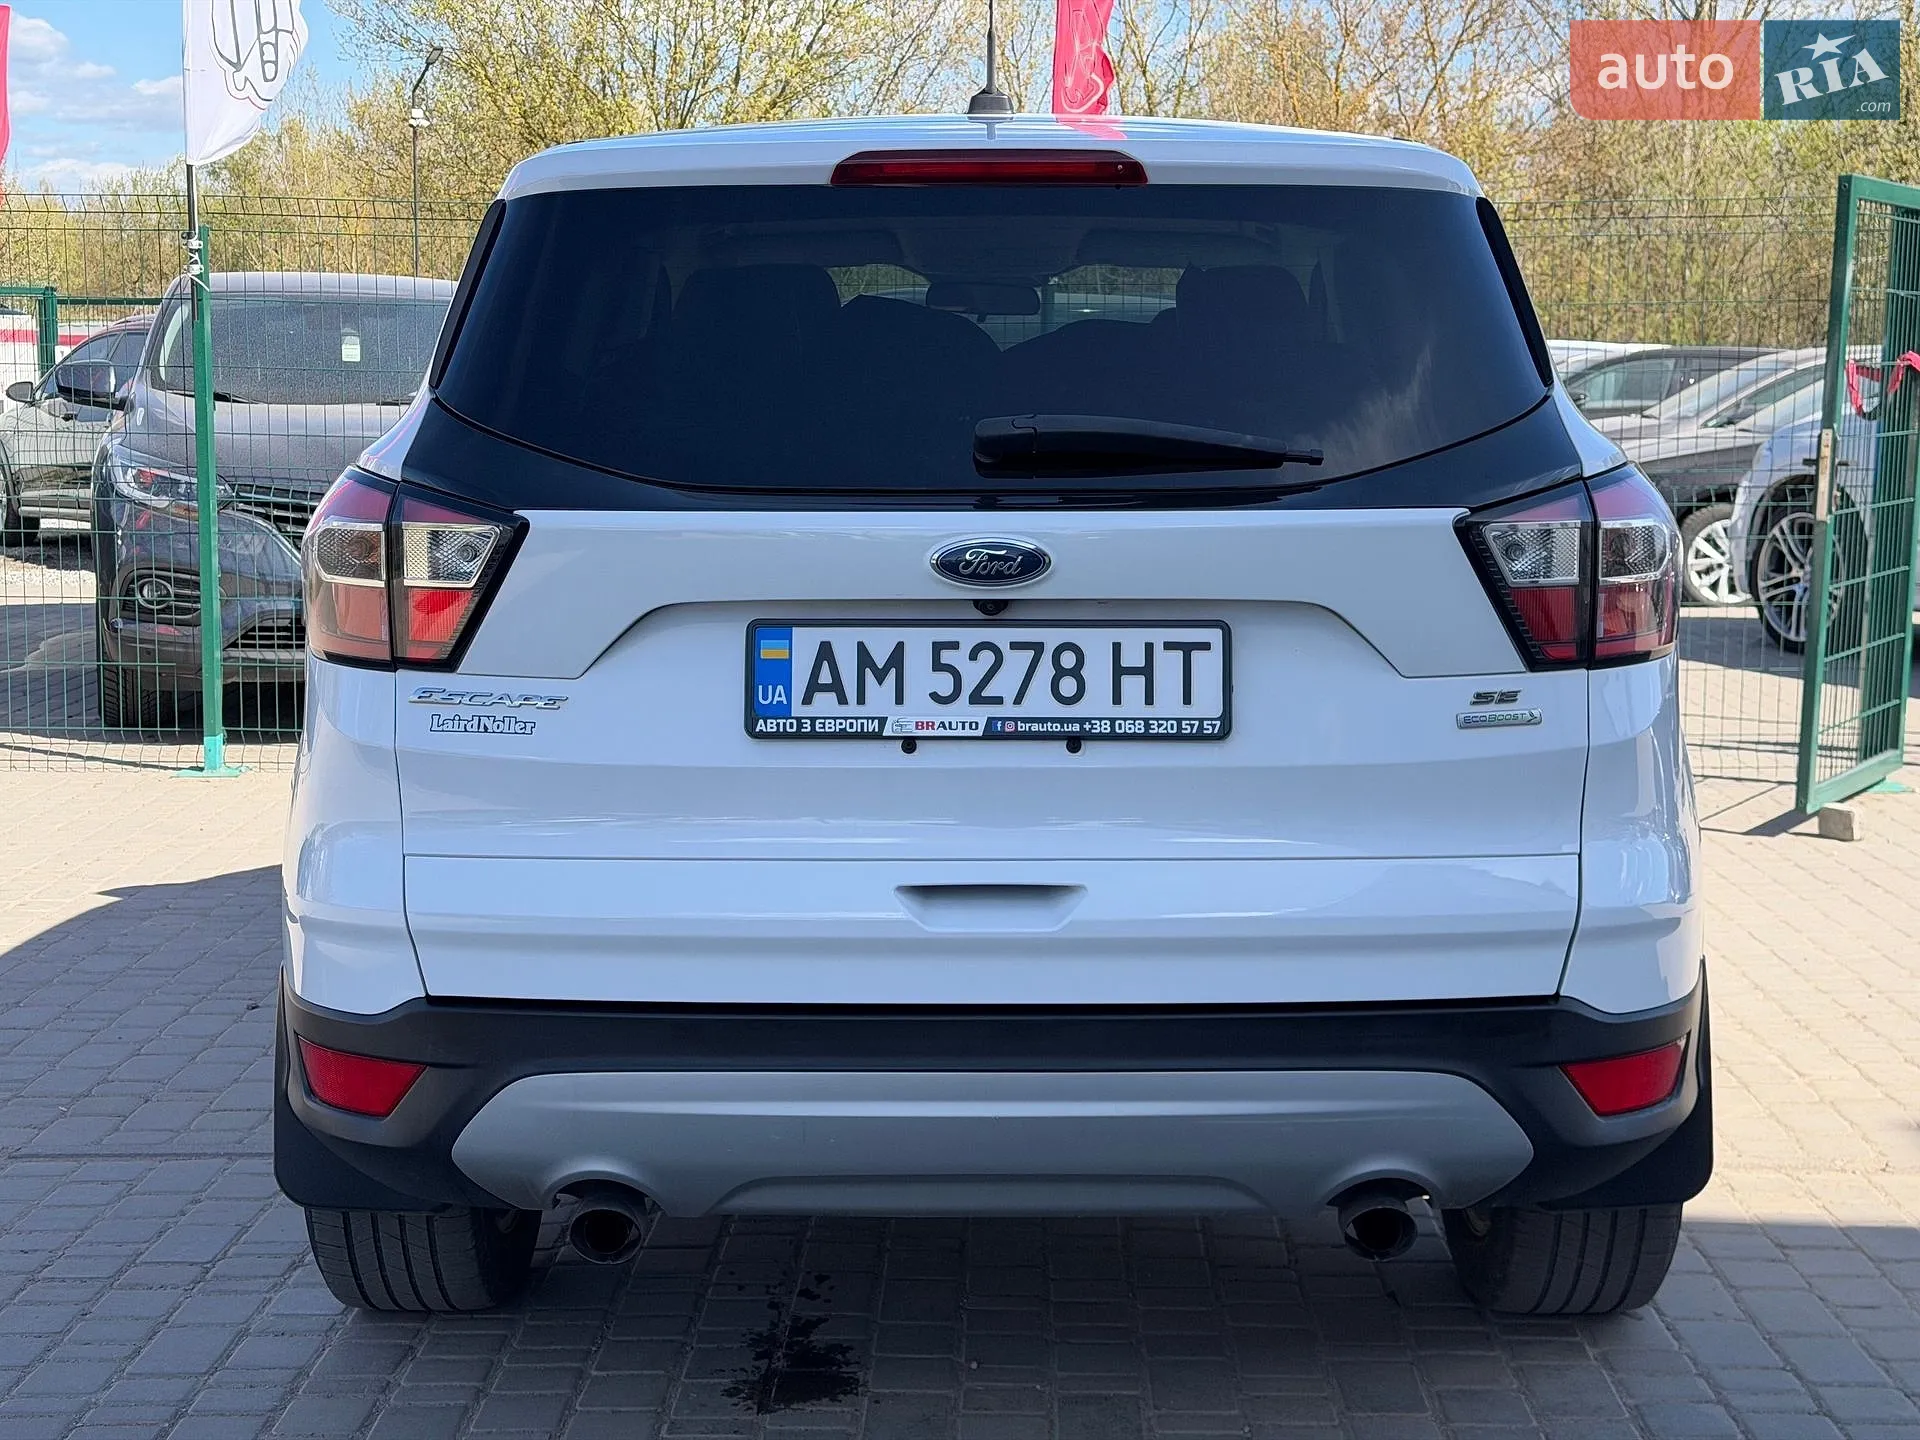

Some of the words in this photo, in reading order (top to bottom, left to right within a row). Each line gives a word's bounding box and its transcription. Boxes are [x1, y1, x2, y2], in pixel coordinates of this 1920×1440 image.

[958, 548, 1022, 576] Ford
[801, 641, 905, 706] AM
[928, 641, 1086, 706] 5278
[1111, 641, 1212, 706] HT
[408, 686, 569, 710] ESCAPE
[758, 685, 788, 705] UA
[1470, 690, 1522, 706] SE
[755, 719, 797, 732] АВТО
[815, 719, 879, 732] ЄВРОПИ
[914, 720, 979, 731] BRAUTO
[1017, 720, 1080, 732] brauto.ua
[1083, 719, 1111, 733] +38
[1115, 719, 1144, 733] 068
[1149, 719, 1177, 734] 320
[1181, 720, 1199, 734] 57
[1203, 720, 1221, 734] 57
